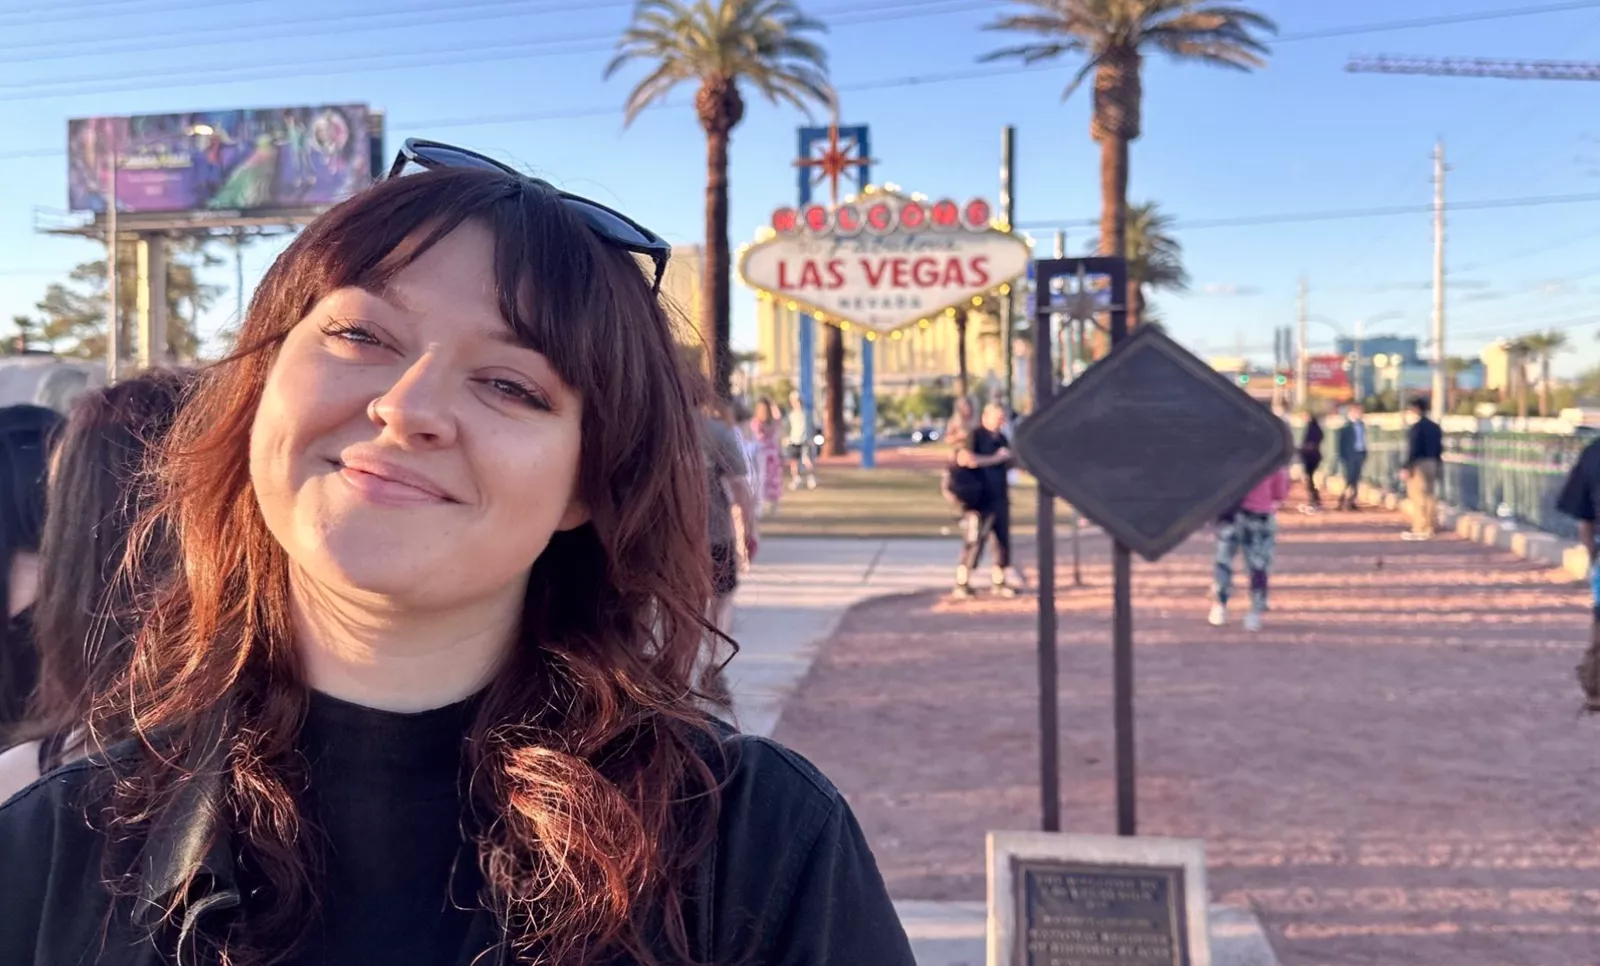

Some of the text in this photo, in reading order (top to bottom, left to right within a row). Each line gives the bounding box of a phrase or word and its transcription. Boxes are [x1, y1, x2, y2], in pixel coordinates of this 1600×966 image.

[772, 199, 991, 232] WELCOME
[777, 255, 990, 291] LAS VEGAS
[838, 295, 923, 310] NEVADA
